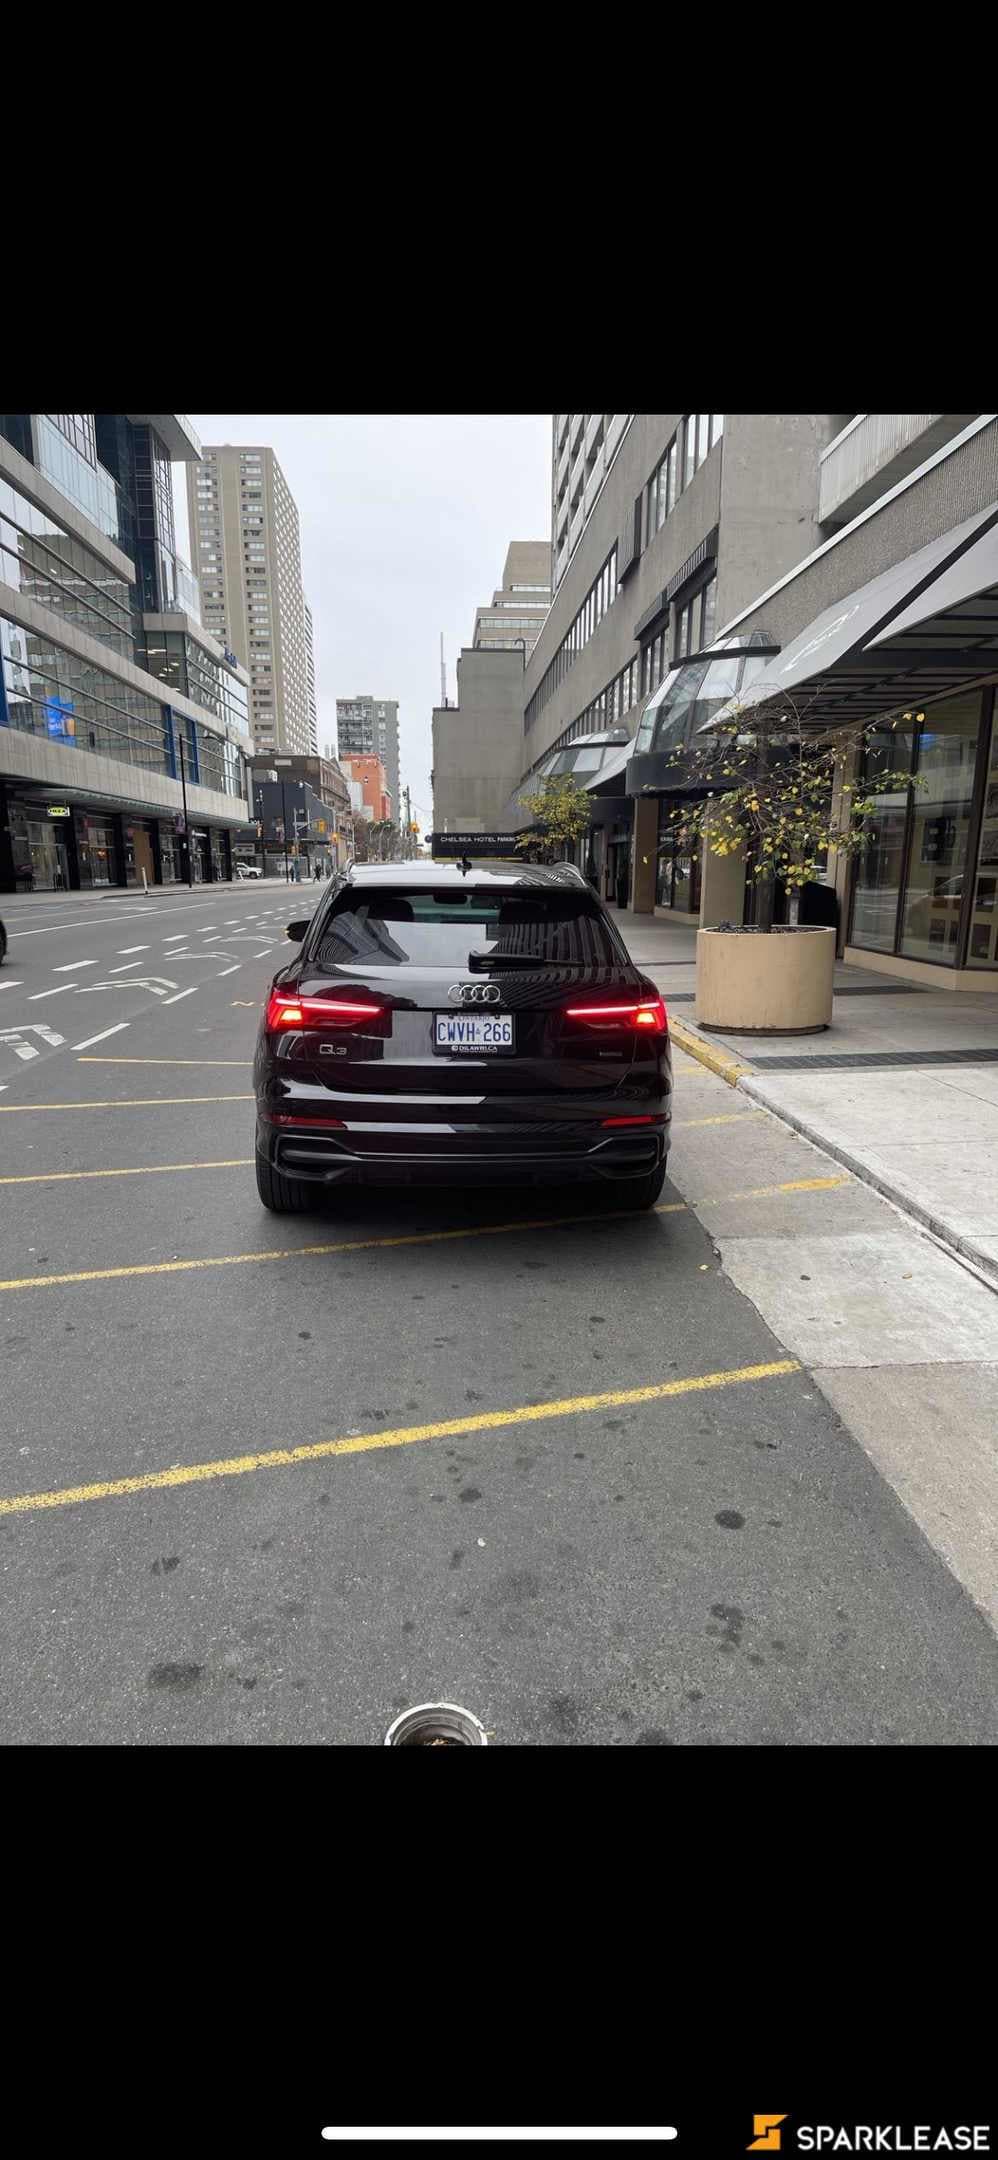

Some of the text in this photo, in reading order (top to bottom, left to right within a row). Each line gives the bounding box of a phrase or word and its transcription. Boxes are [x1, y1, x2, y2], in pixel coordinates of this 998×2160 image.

[437, 1022, 511, 1042] CWVH 266
[319, 1044, 347, 1055] Q3
